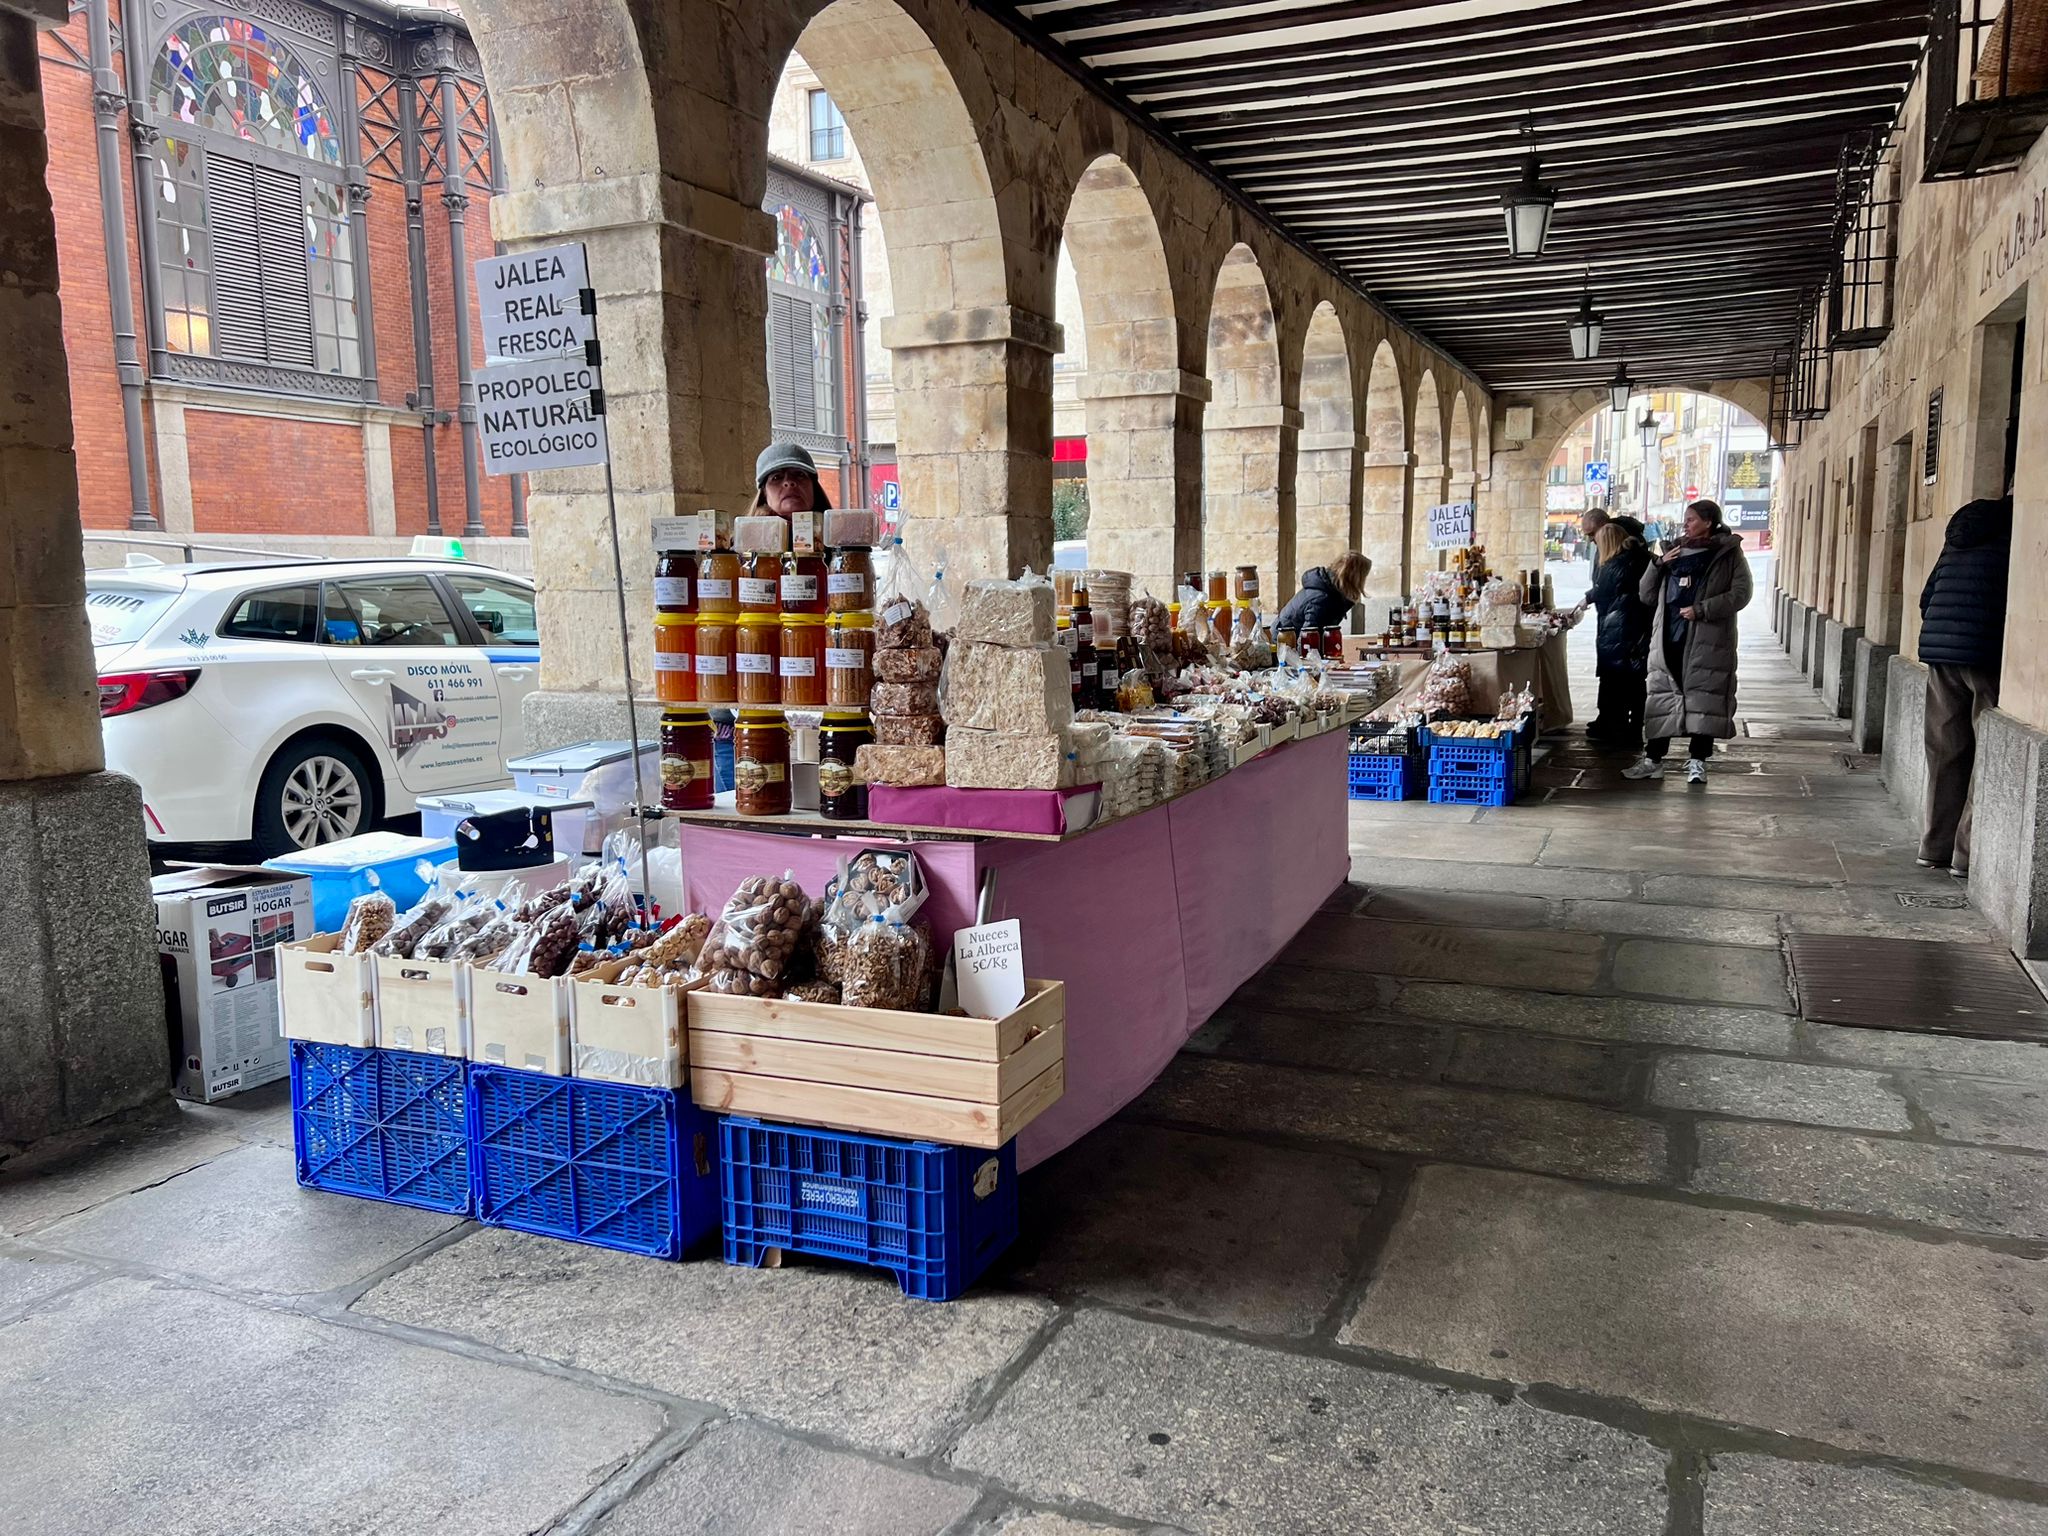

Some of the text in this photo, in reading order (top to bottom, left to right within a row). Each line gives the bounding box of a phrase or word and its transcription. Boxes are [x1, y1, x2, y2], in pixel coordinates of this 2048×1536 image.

[495, 256, 566, 289] JALEA
[505, 293, 563, 324] REAL
[498, 326, 577, 356] FRESCA
[478, 370, 592, 403] PROPOLEO
[484, 400, 597, 434] NATURAL
[490, 431, 598, 459] ECOLÓGICO
[887, 484, 897, 507] P
[1429, 504, 1472, 522] JALEA
[1436, 519, 1469, 536] REAL
[407, 661, 472, 677] DISCO MÓVIL
[428, 677, 483, 689] 611 466 991
[209, 900, 245, 915] BUTSIR
[253, 896, 291, 914] HOGAR
[156, 929, 189, 948] OGAR
[969, 929, 1009, 944] Nueces
[960, 942, 1019, 960] La Alberca
[212, 1078, 240, 1093] BUTSIR
[825, 1190, 859, 1208] HERRERO
